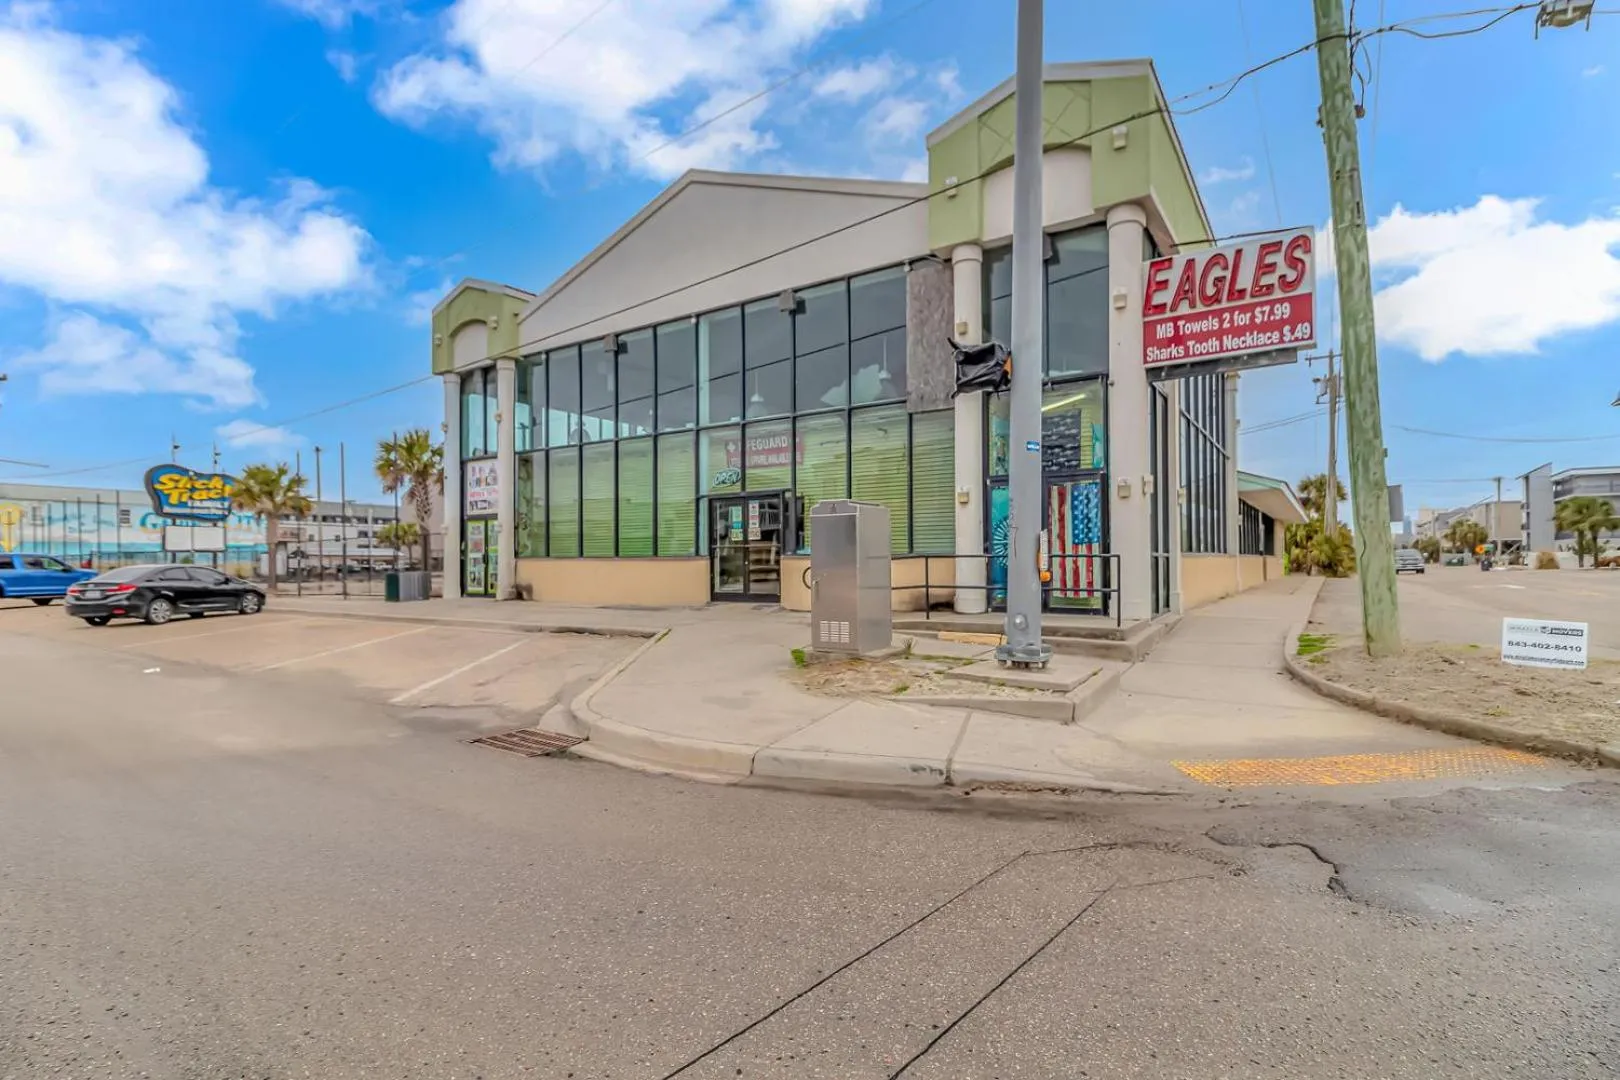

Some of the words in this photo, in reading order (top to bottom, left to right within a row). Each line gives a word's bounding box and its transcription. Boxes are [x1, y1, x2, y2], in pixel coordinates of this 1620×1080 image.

[1143, 234, 1311, 315] EAGLES
[1156, 324, 1174, 340] MB
[1177, 317, 1219, 335] Towels
[1222, 314, 1231, 329] 2
[1233, 310, 1251, 326] for
[1254, 302, 1291, 324] $7.99
[1146, 344, 1185, 362] Sharks
[1186, 338, 1220, 355] Tooth
[1223, 330, 1279, 351] Necklace
[1282, 322, 1311, 342] $.49
[154, 473, 225, 490] Slick
[713, 470, 741, 486] OPEN
